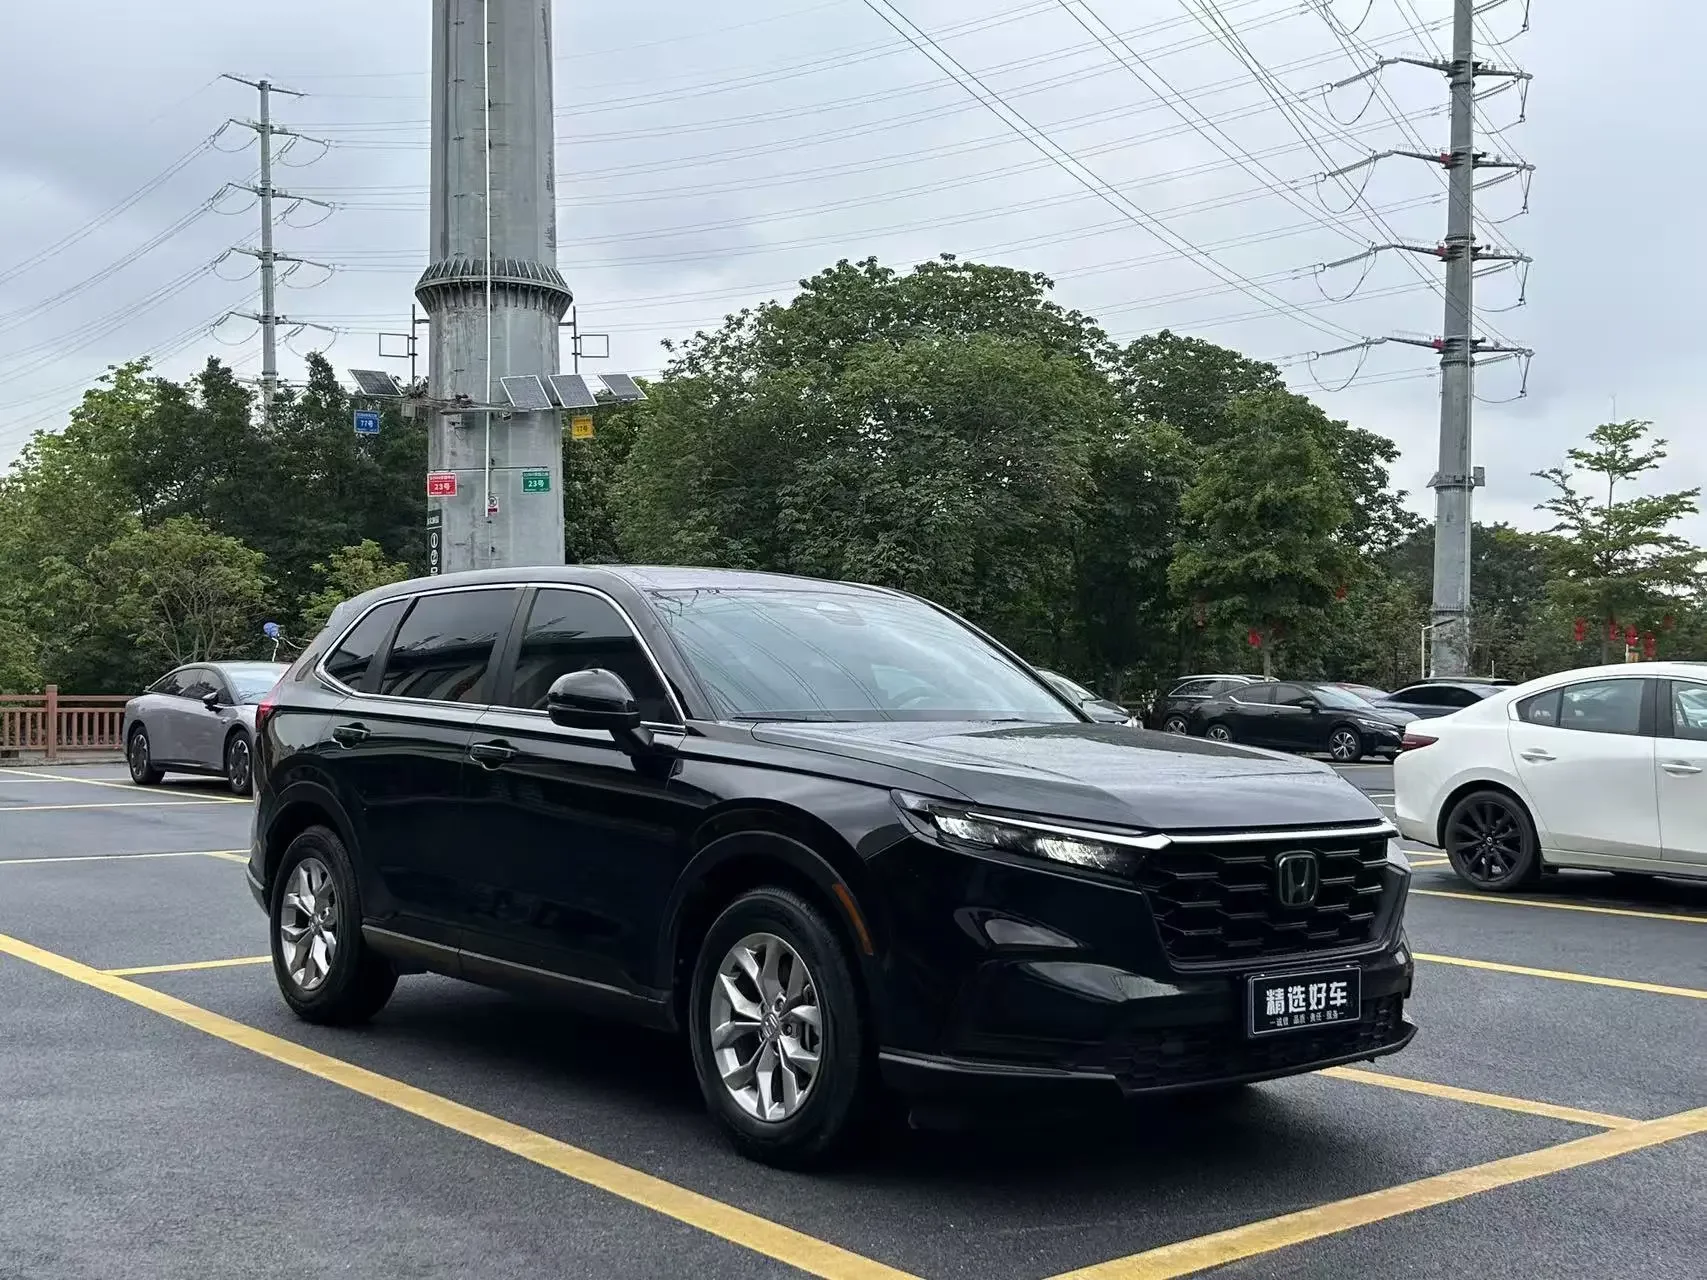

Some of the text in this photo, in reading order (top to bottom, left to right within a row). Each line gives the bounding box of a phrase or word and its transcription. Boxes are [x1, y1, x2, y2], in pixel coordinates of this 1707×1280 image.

[434, 483, 450, 491] 23号
[528, 480, 544, 488] 23号
[1266, 981, 1347, 1016] 精选好车
